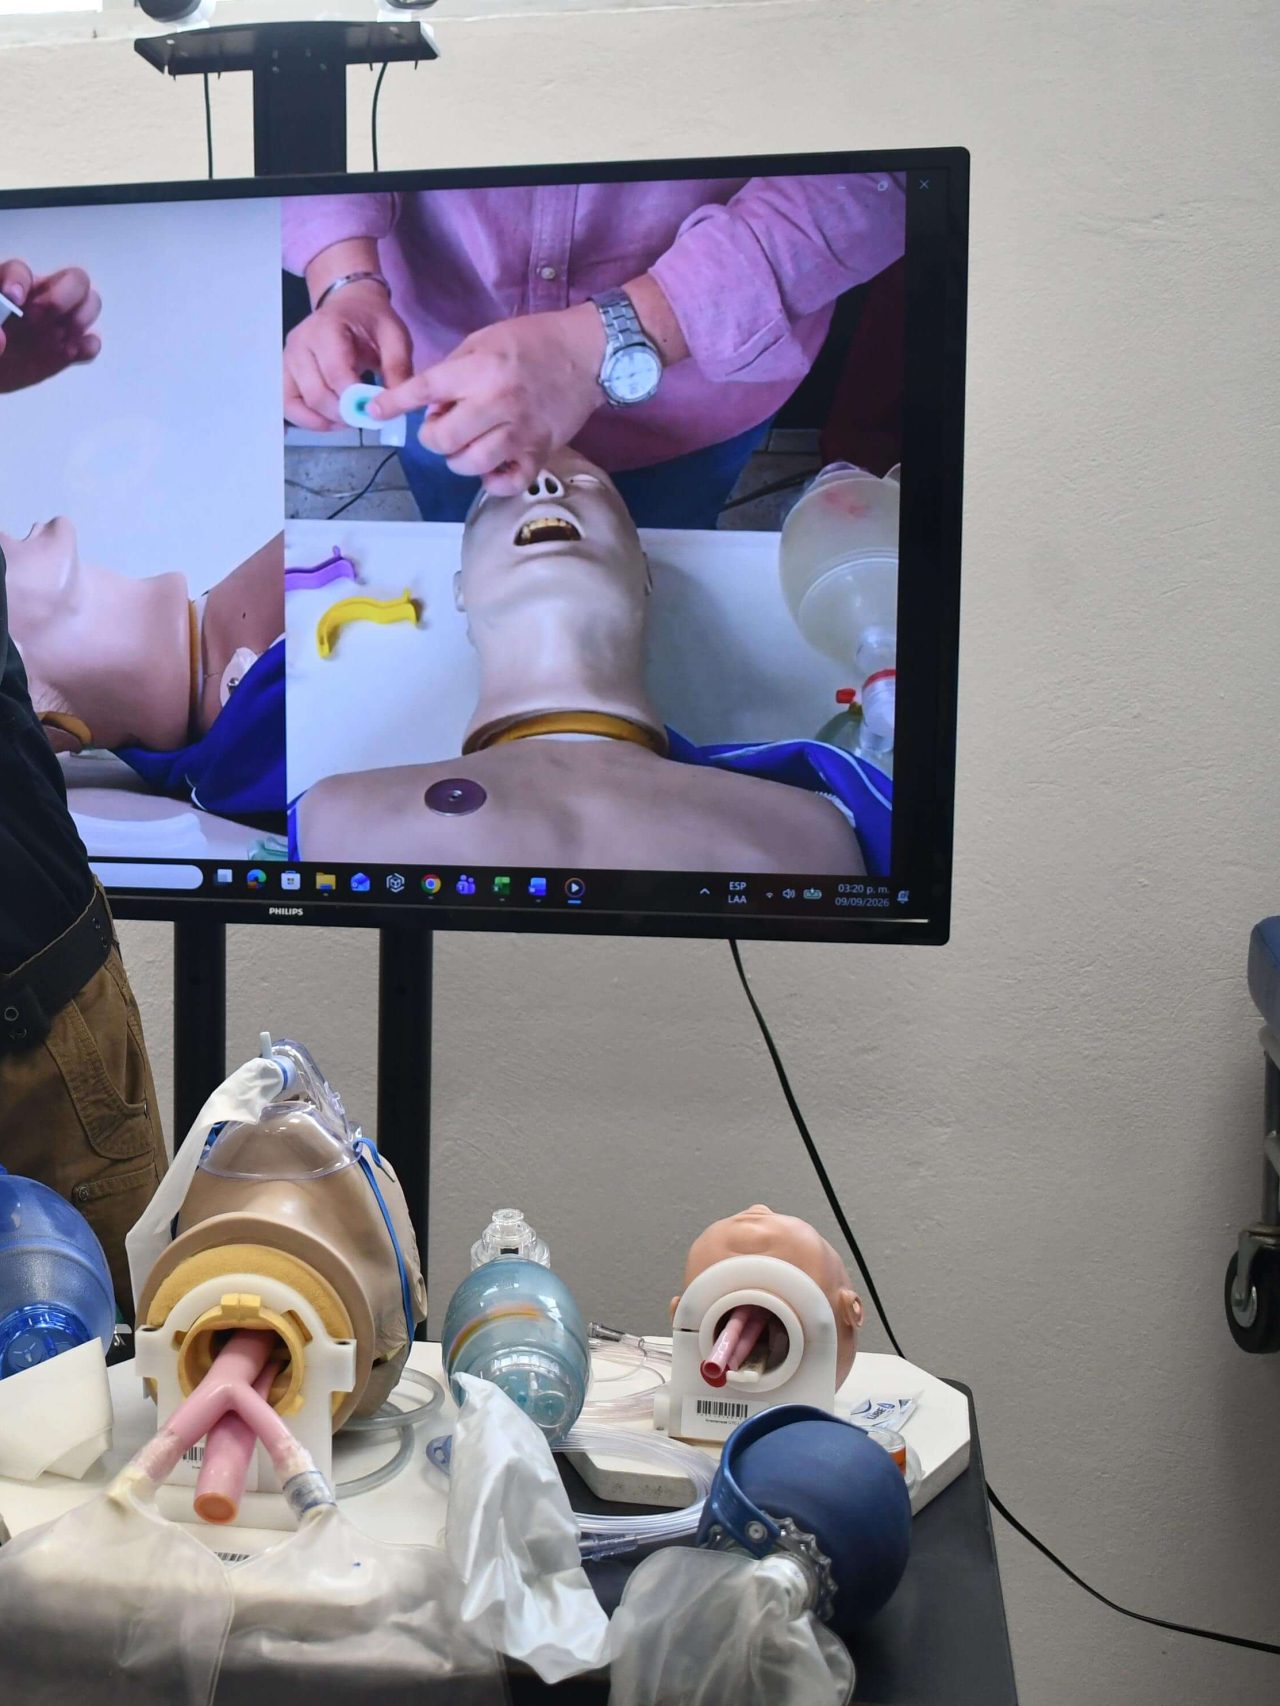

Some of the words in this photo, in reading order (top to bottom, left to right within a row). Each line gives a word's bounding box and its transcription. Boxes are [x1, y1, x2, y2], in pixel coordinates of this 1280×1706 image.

[729, 881, 747, 891] ESP
[838, 884, 864, 893] 03:20
[728, 894, 747, 904] LAA
[269, 907, 304, 916] PHILIPS
